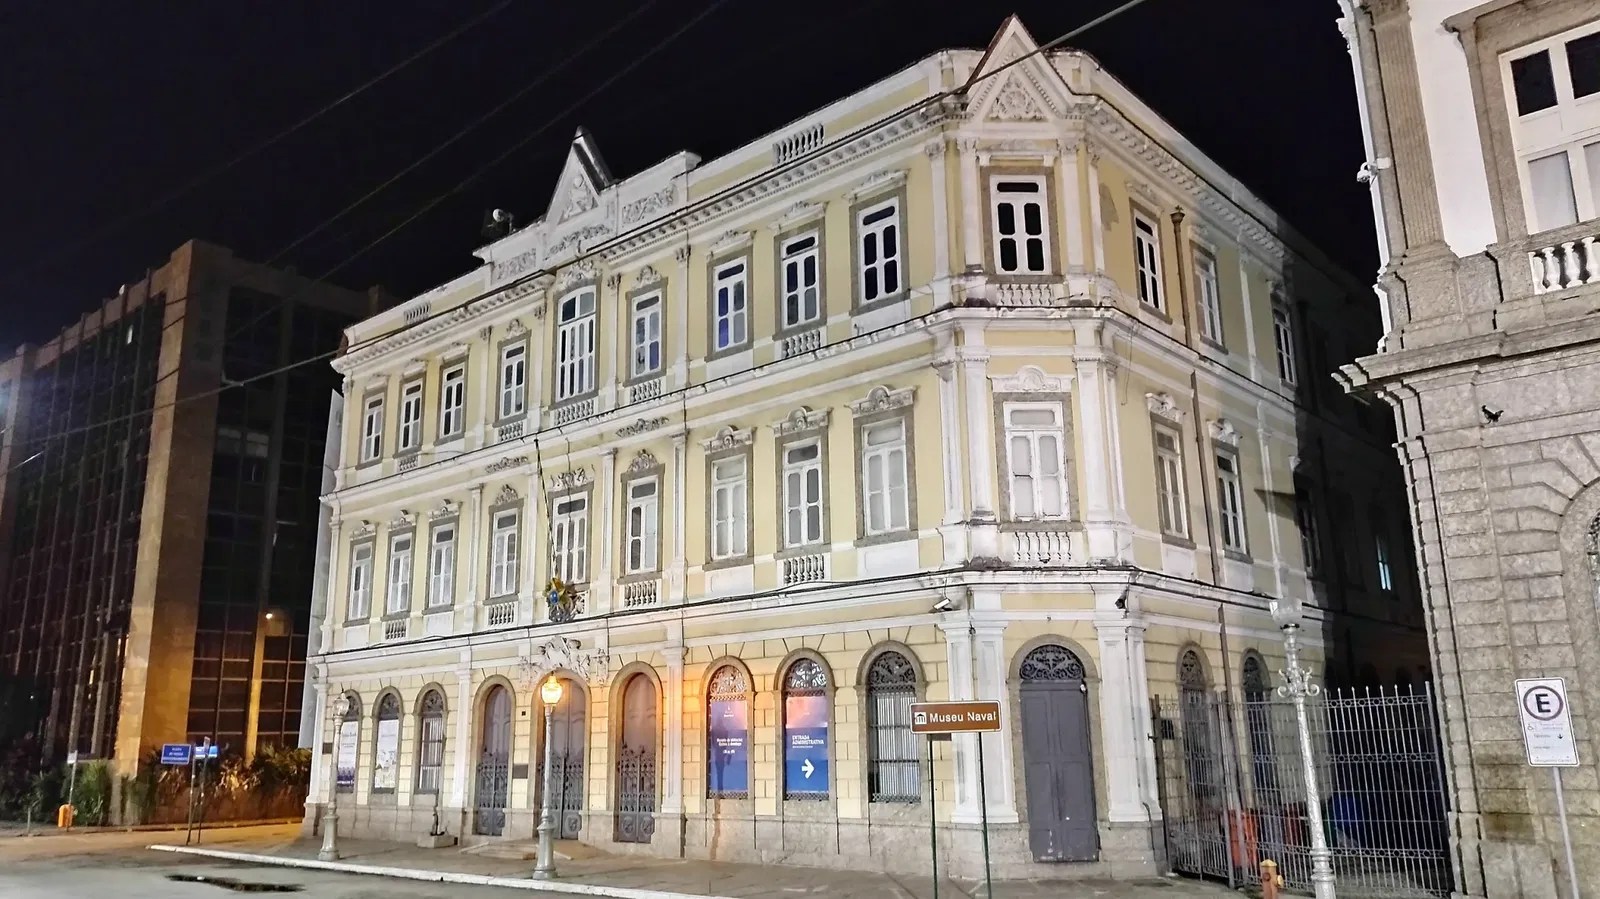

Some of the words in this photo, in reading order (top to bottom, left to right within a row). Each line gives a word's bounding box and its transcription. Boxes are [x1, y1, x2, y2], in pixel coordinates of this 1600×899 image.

[1535, 693, 1551, 713] E
[929, 712, 964, 723] Museu
[967, 711, 997, 721] Naval
